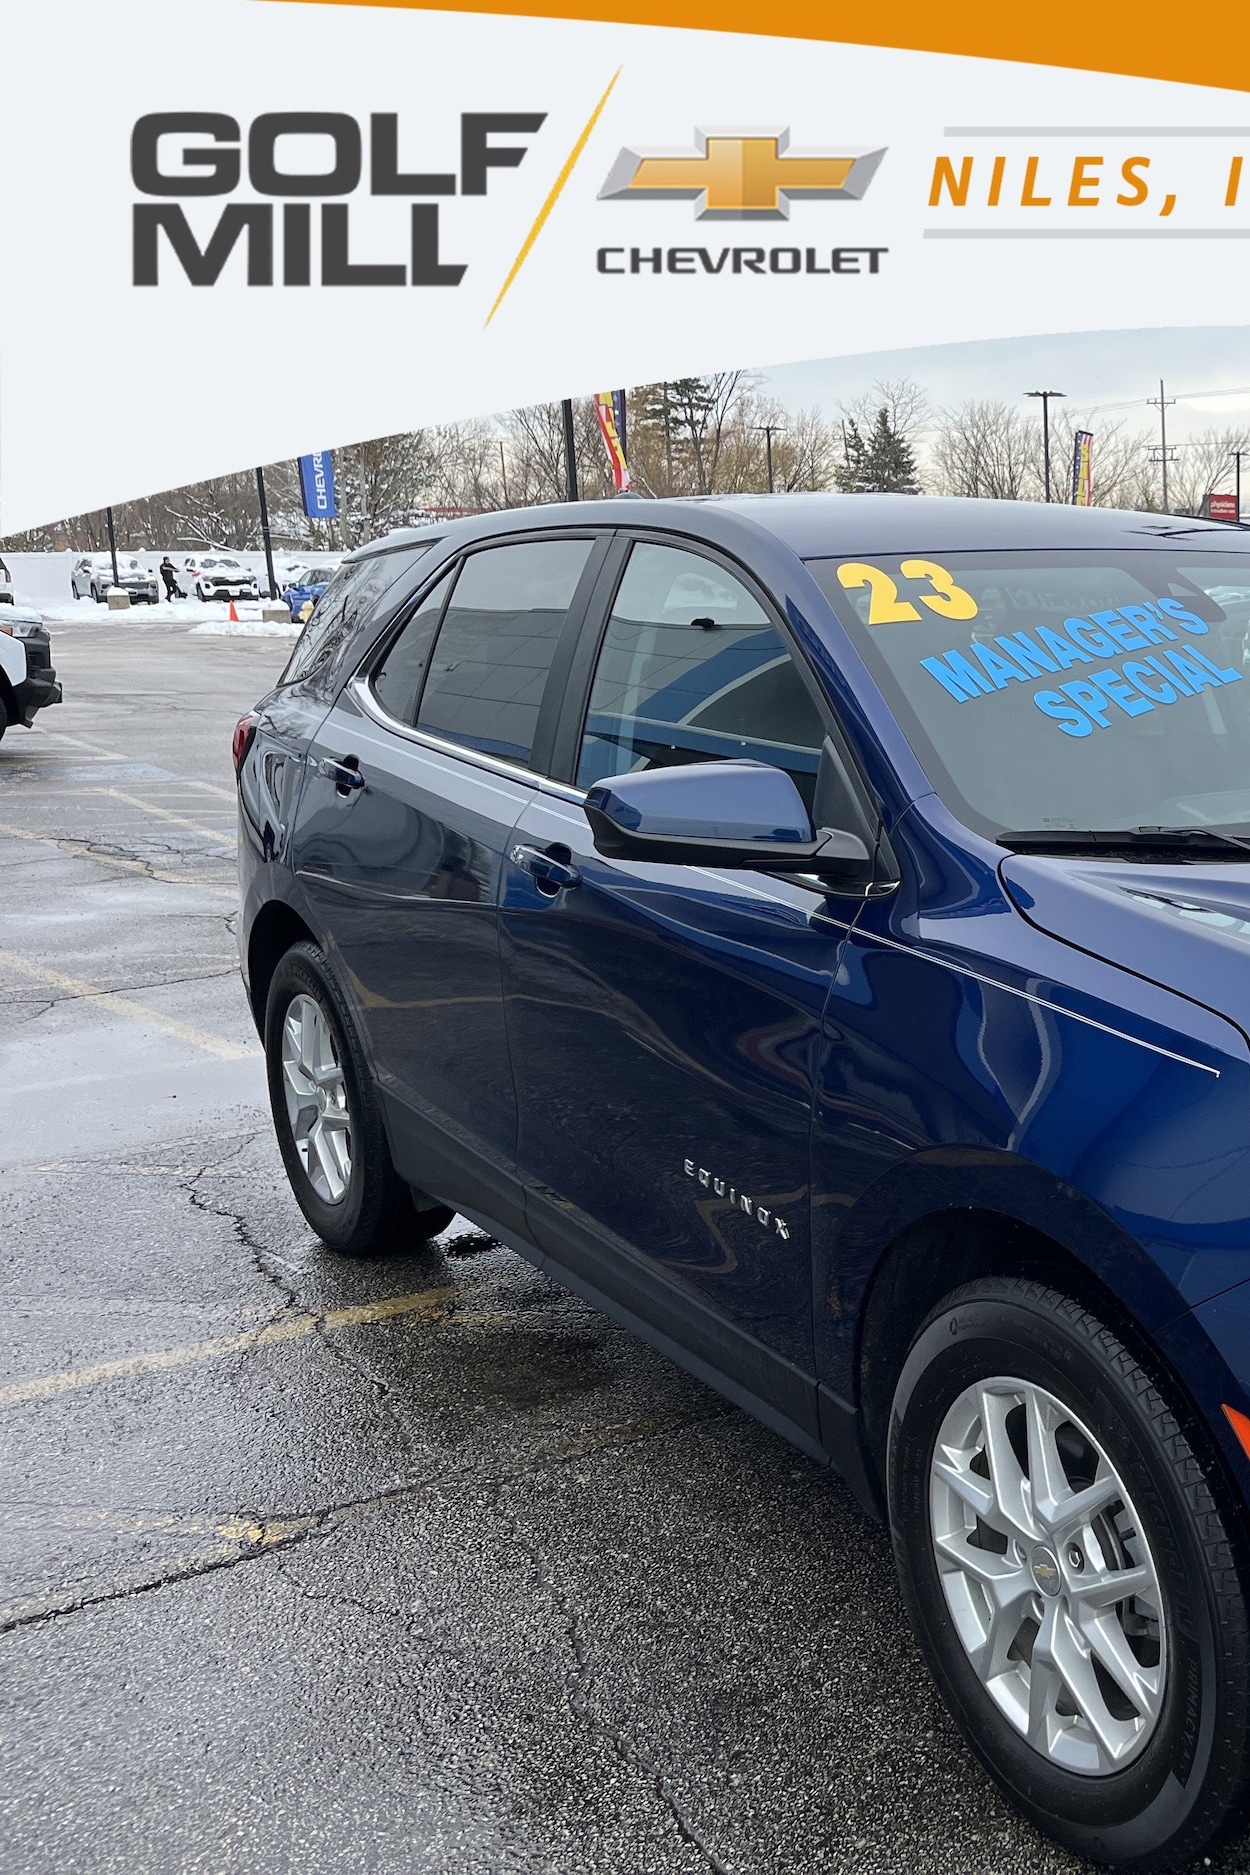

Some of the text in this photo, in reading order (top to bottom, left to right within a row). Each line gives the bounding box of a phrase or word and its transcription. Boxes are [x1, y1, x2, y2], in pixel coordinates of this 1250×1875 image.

[836, 559, 979, 626] 23
[920, 597, 1210, 704] MANAGER'S
[1034, 645, 1243, 738] SPECIAL
[683, 1158, 791, 1240] EQUINOX
